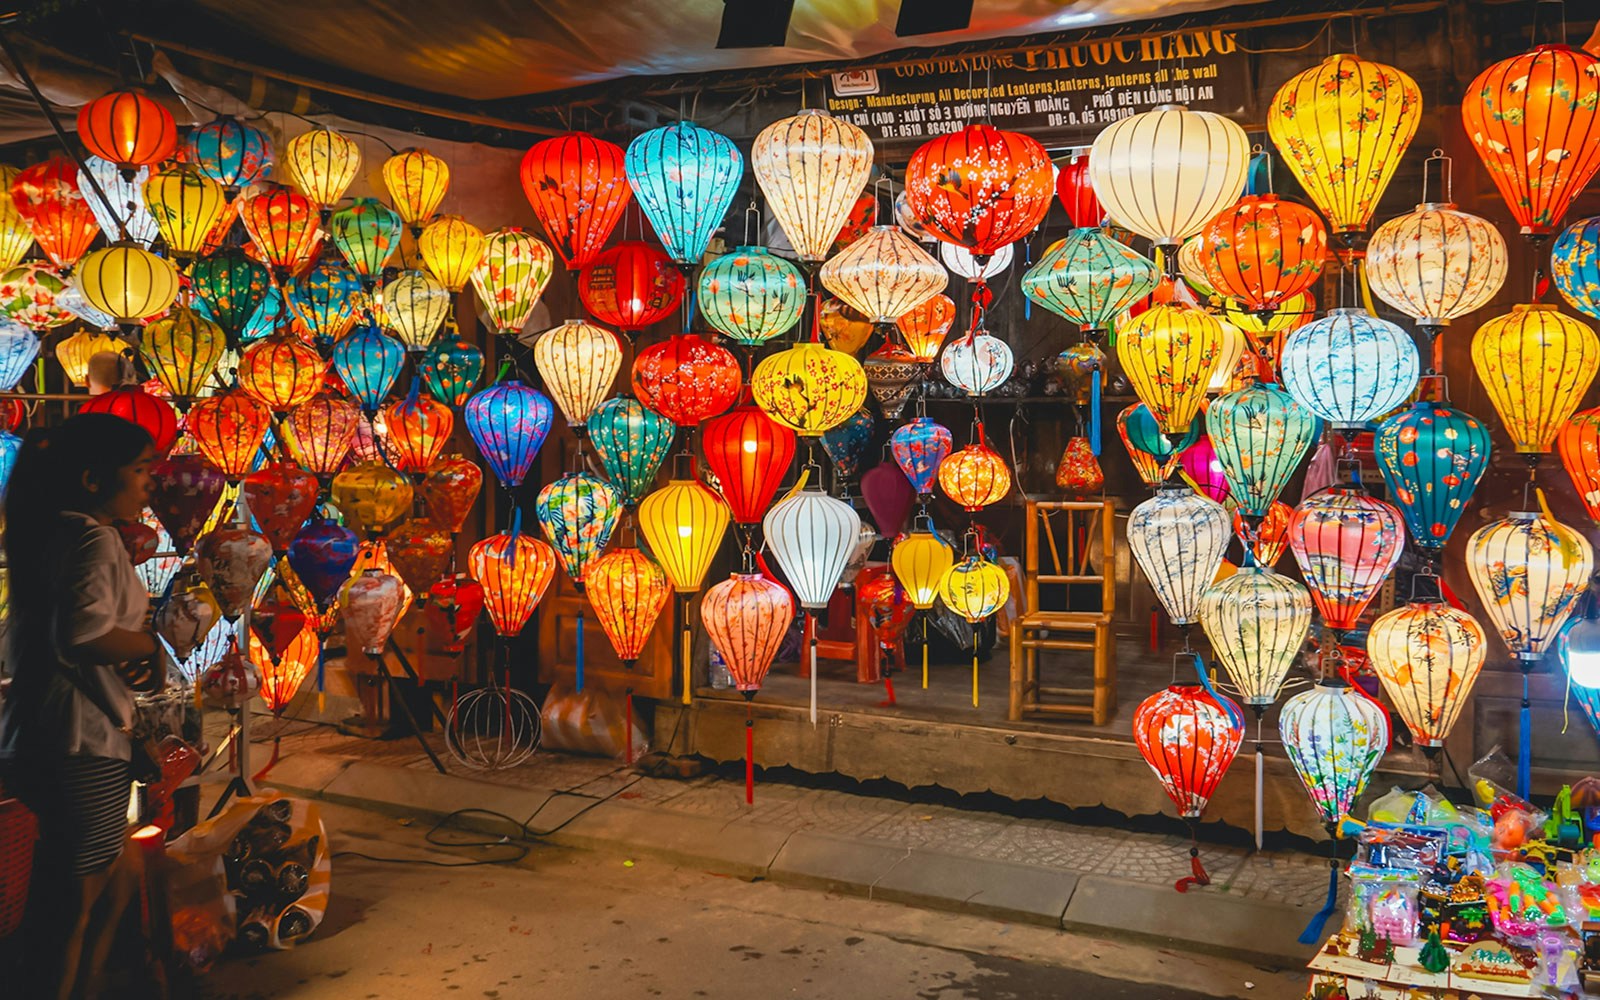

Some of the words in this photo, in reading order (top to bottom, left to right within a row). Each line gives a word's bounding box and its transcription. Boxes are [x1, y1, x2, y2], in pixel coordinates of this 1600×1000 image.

[829, 98, 863, 111] Design:
[866, 92, 936, 107] Manufacturing
[939, 88, 951, 101] All
[1105, 72, 1151, 88] lanterns
[1154, 69, 1168, 83] all
[1193, 64, 1217, 79] wall
[943, 106, 952, 120] 3
[990, 96, 1031, 116] NGUYỄN
[1034, 94, 1070, 113] HOÀNG
[1092, 87, 1115, 108] PHỐ
[1175, 84, 1195, 105] HỘI
[1198, 86, 1214, 100] AN
[899, 123, 922, 137] 0510
[926, 120, 964, 136] 864200
